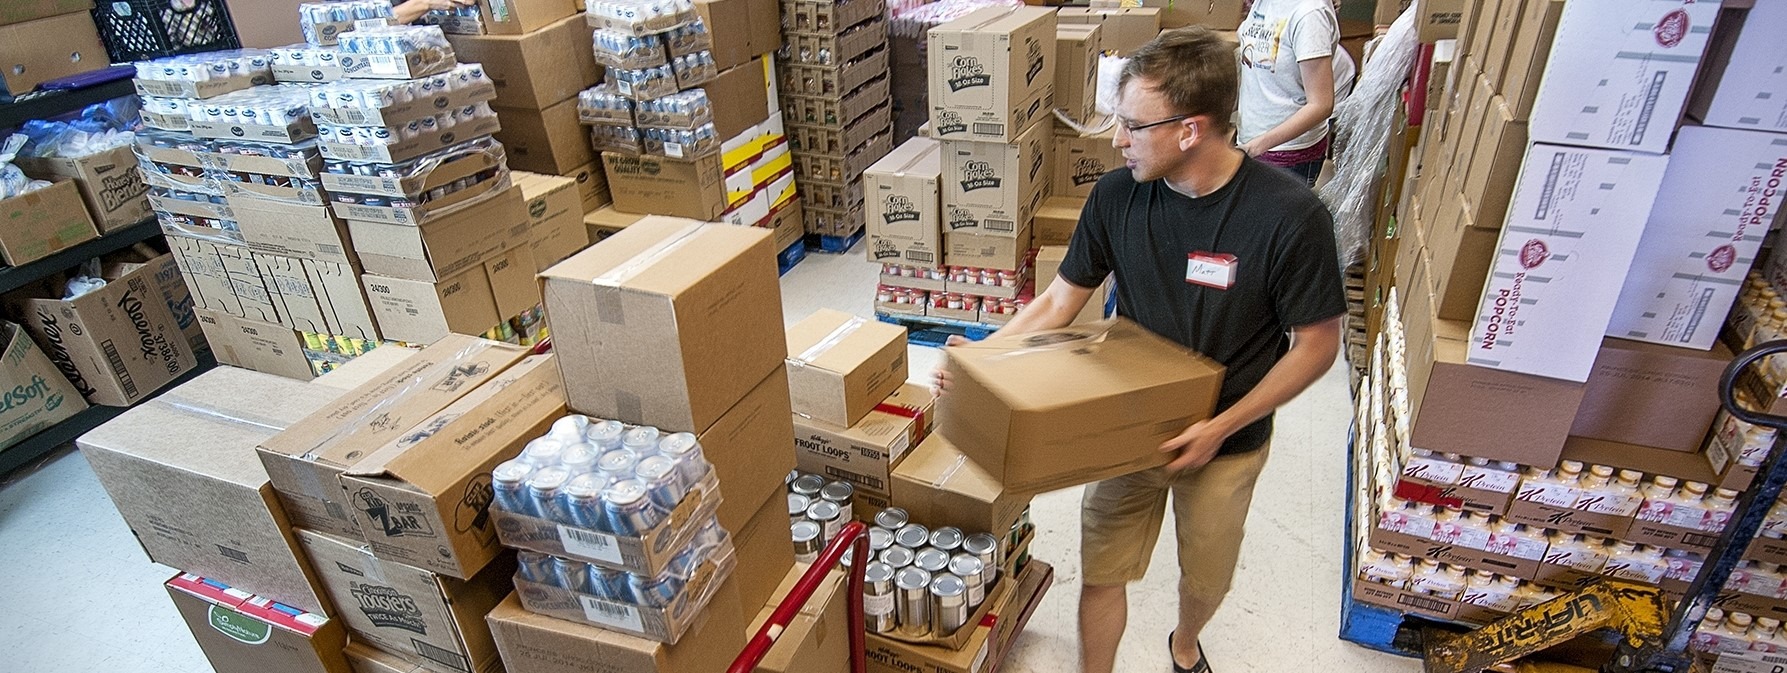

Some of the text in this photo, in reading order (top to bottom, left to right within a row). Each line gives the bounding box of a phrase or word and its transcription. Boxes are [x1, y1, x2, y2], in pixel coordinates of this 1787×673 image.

[953, 55, 978, 68] Corn
[971, 76, 984, 84] Size
[609, 156, 640, 166] WE GROW
[614, 164, 641, 175] QUALITY
[965, 159, 990, 171] Corn
[886, 193, 908, 205] Corn
[1749, 158, 1787, 225] POPCORN
[1732, 176, 1763, 242] Ready-To-Eat
[370, 284, 391, 294] 24/300
[1504, 272, 1526, 335] Ready-To-Eat
[117, 289, 158, 361] Kleenex
[1481, 288, 1511, 350] POPCORN
[153, 332, 180, 376] 37386 00
[795, 438, 821, 452] FROOT
[822, 445, 851, 460] LOOPS
[1404, 464, 1449, 482] K Protein
[1459, 473, 1506, 491] K Protein
[1516, 487, 1566, 506] K Protein
[1576, 496, 1626, 514] K Protein
[390, 514, 422, 530] BAR
[1562, 516, 1593, 527] Protein
[1440, 551, 1473, 563] Protein
[1543, 552, 1592, 571] K Protein
[1602, 563, 1650, 581] K Protein
[350, 591, 418, 614] Toasters
[367, 612, 387, 621] TWICE
